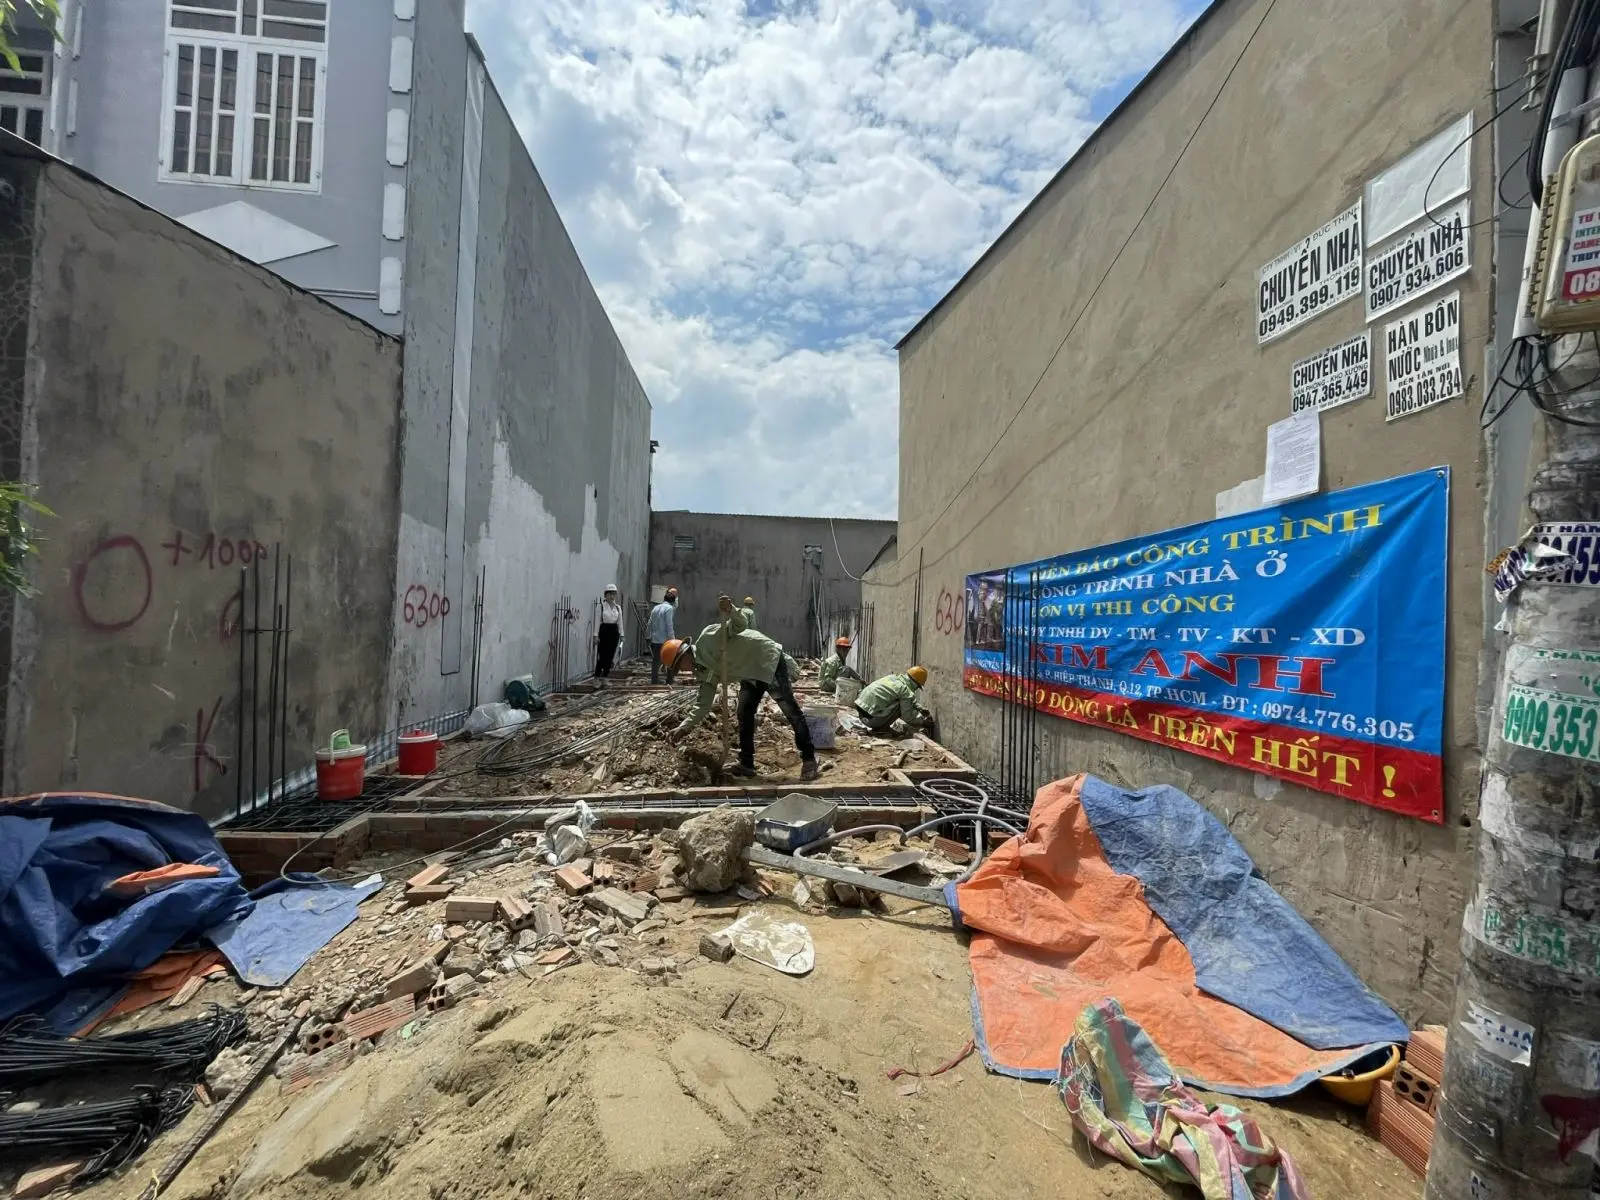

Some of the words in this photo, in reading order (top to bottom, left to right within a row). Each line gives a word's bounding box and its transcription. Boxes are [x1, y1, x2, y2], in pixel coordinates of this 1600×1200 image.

[1260, 237, 1321, 314] CHUYỂN
[1327, 213, 1361, 275] NHÀ
[1369, 232, 1425, 290] CHUYỂN
[1430, 211, 1464, 258] NHÀ
[1370, 246, 1464, 311] 0907.934.606
[1259, 265, 1360, 337] 0949.399.119
[1388, 318, 1419, 355] HÀN
[1424, 299, 1458, 338] BỒN
[1293, 347, 1338, 389] CHUYỂN
[1341, 335, 1368, 370] NHÀ
[1388, 345, 1421, 383] NƯỚC
[1292, 369, 1369, 413] 0947.365.449
[1388, 367, 1461, 417] 0983.033.234
[1075, 554, 1119, 575] BÁO
[1126, 536, 1210, 567] CÔNG
[1222, 503, 1385, 551] TRÌNH
[1082, 573, 1155, 597] TRÌNH
[1164, 559, 1241, 587] NHÀ
[1255, 549, 1289, 578] Ở
[1067, 602, 1086, 620] VỊ
[1092, 600, 1133, 617] THI
[1141, 593, 1237, 615] CÔNG
[1049, 625, 1086, 638] TNHH
[1090, 627, 1113, 639] DV
[1127, 627, 1156, 641] TM
[1177, 628, 1210, 642] TV
[1230, 627, 1277, 644] KT
[1310, 627, 1366, 646] XD
[1027, 642, 1113, 672] KIM
[1130, 648, 1336, 699] ANH
[1049, 691, 1100, 720] ĐỘNG
[1106, 702, 1140, 731] LÀ
[1148, 711, 1239, 756] TRÊN
[1250, 735, 1360, 788] HẾT
[1262, 701, 1415, 743] 0974.776.305
[1504, 694, 1600, 758] 0909.353.
